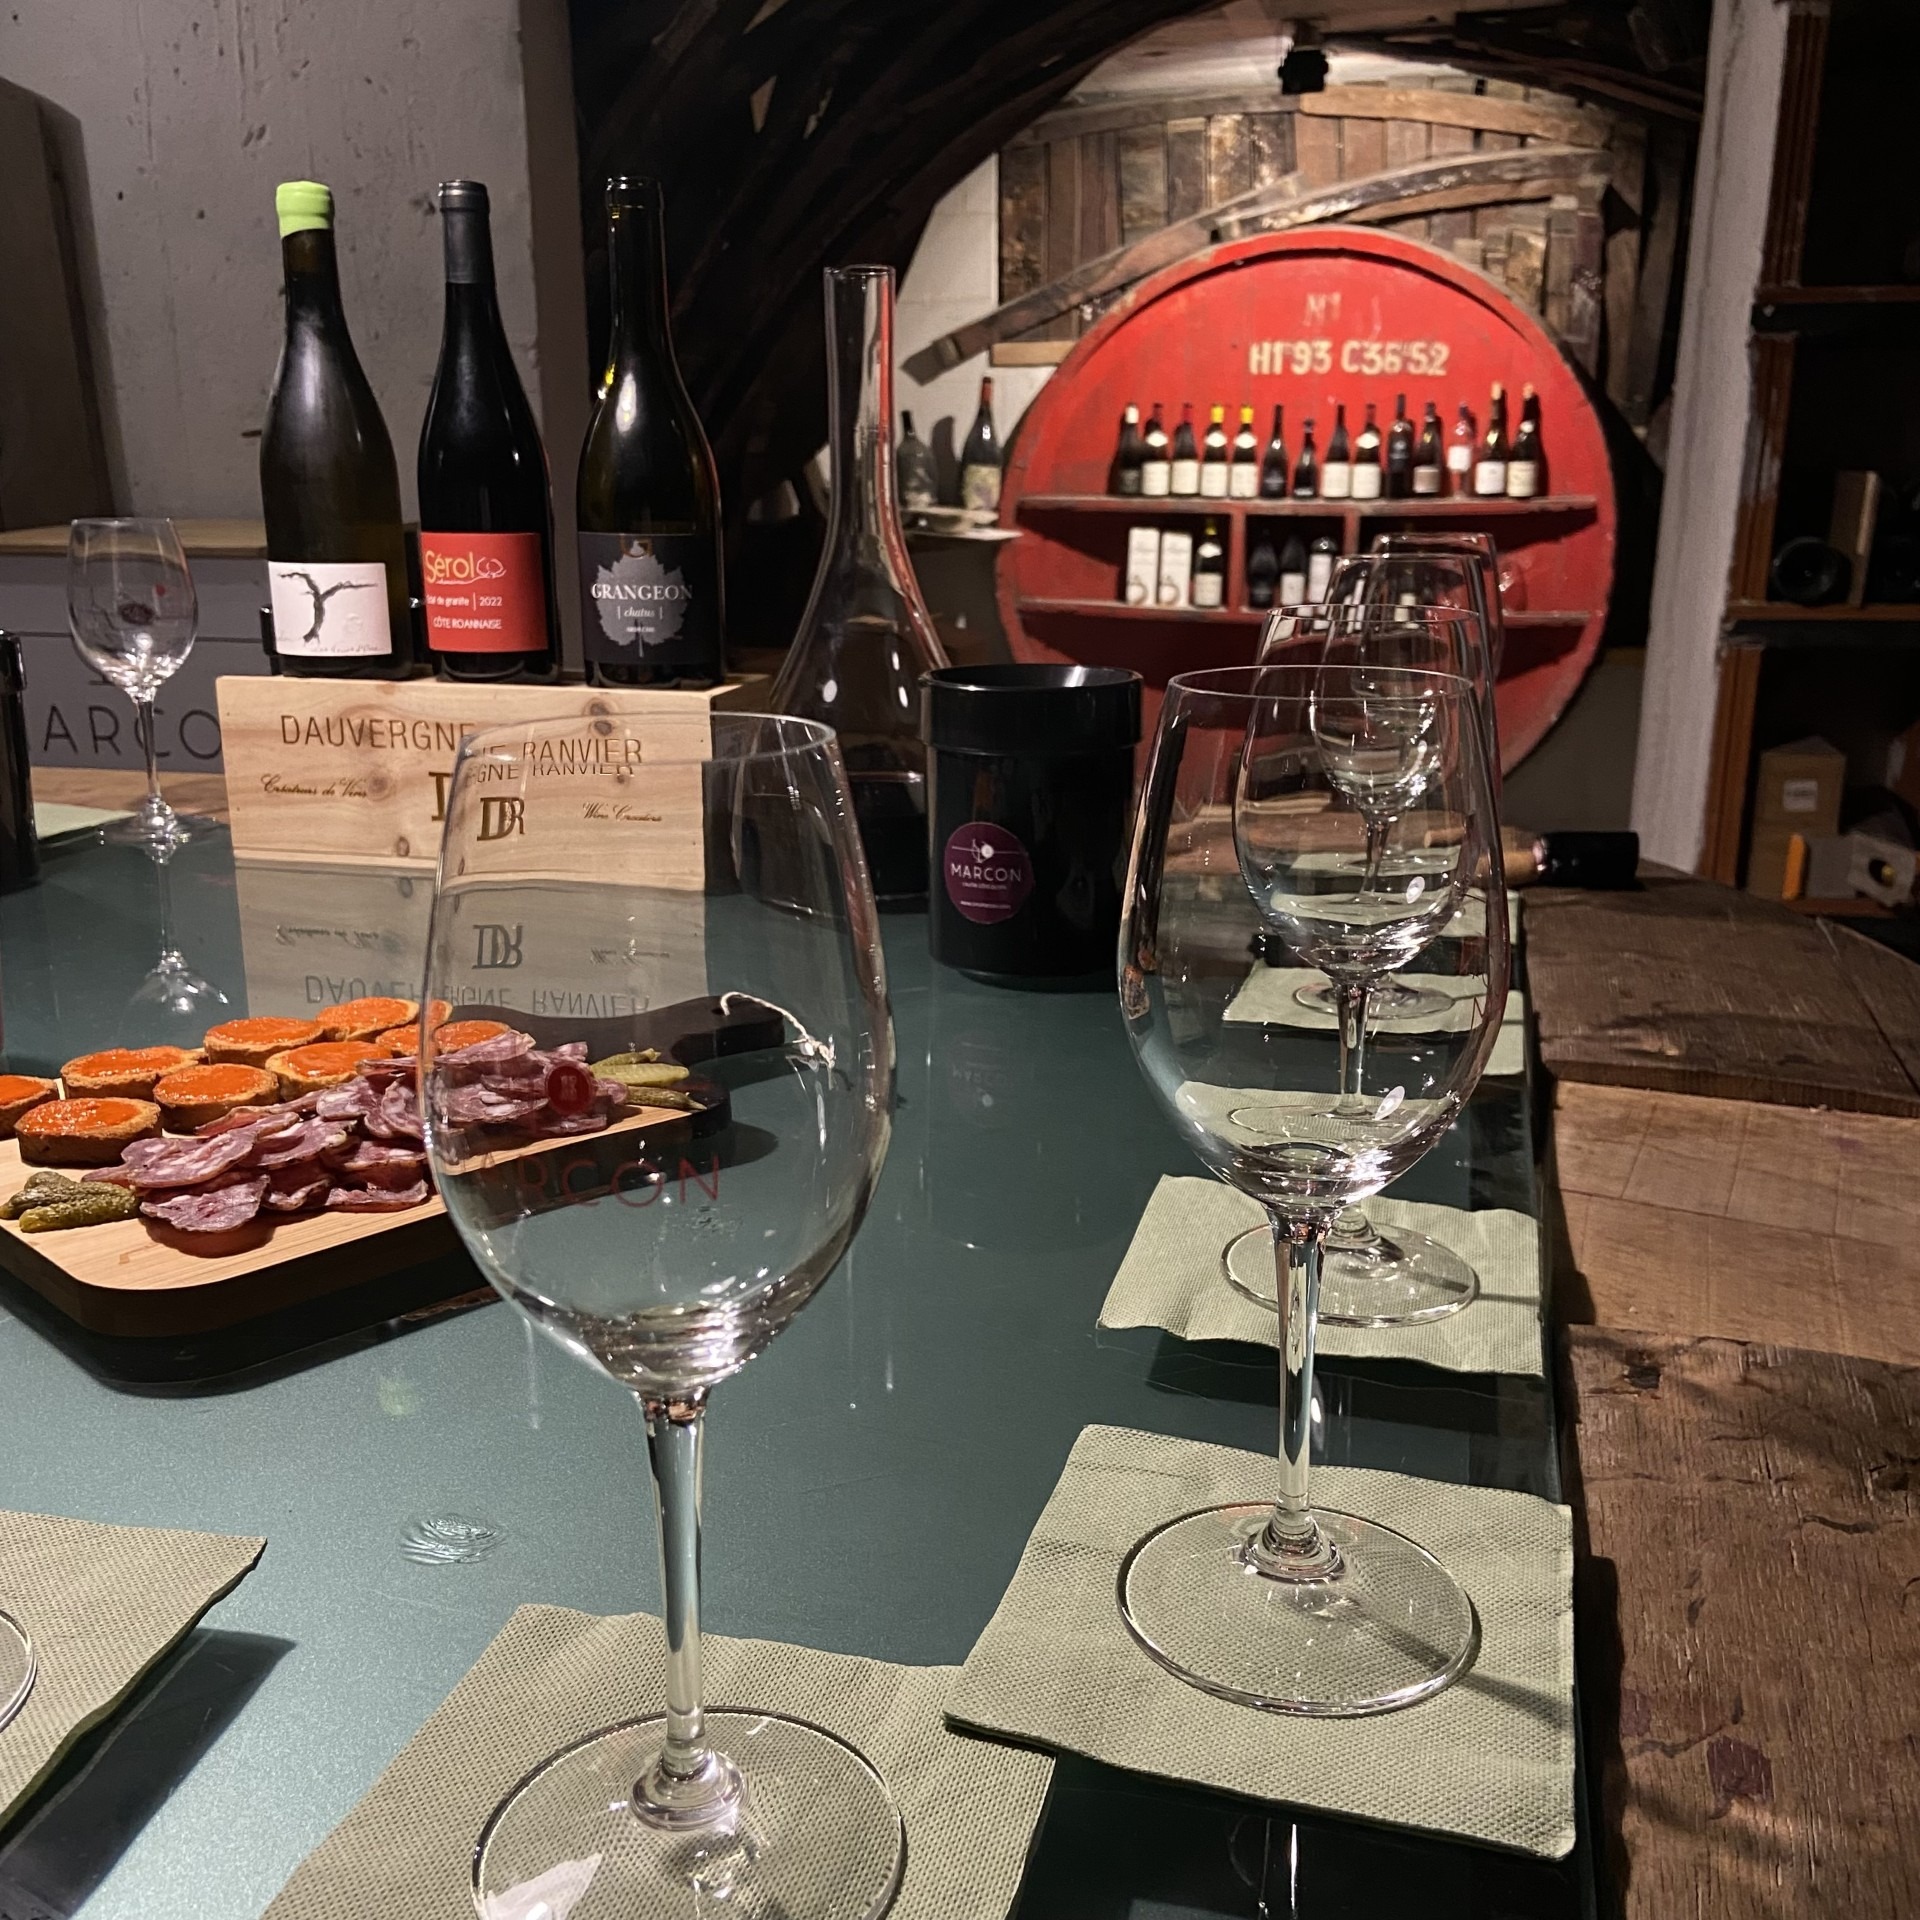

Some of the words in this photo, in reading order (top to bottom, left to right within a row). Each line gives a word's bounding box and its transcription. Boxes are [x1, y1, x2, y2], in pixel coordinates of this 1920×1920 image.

[425, 550, 475, 583] Sérol
[591, 583, 693, 600] GRANGEON
[479, 596, 503, 607] 2022
[451, 618, 502, 630] ROANNAISE
[44, 705, 221, 760] ARCO
[522, 738, 643, 764] RANVIER
[951, 863, 1022, 882] MARCON
